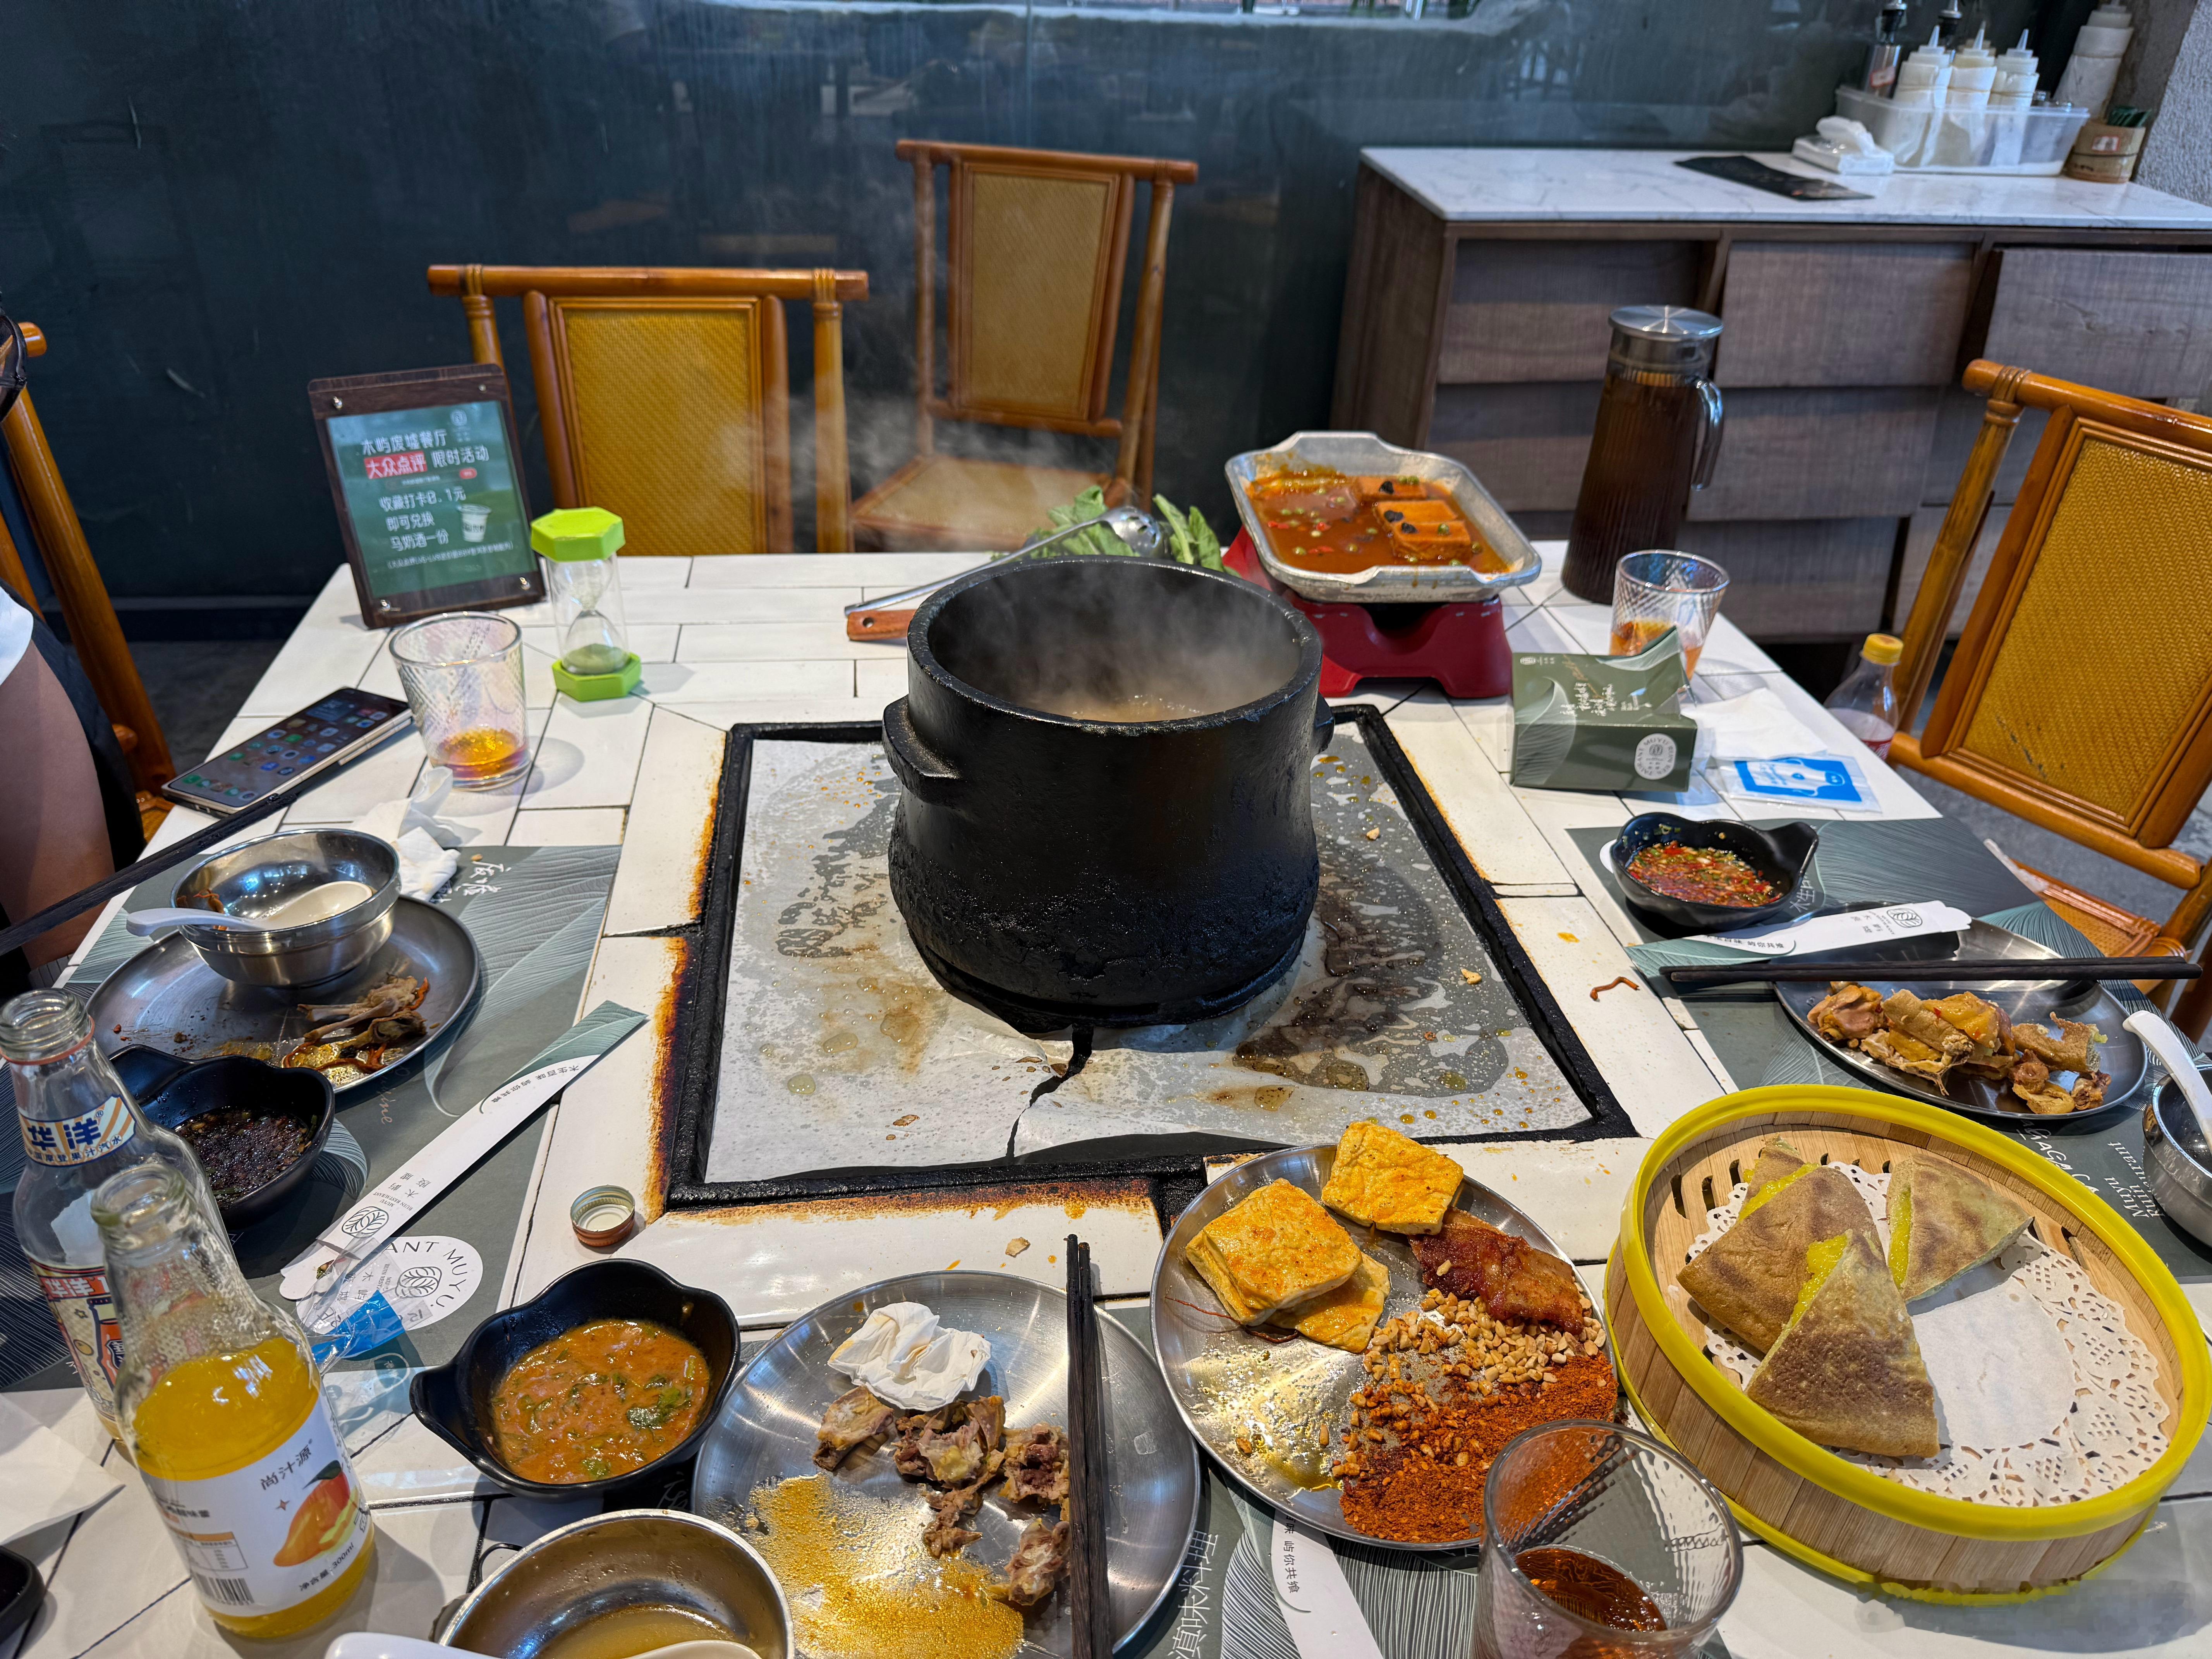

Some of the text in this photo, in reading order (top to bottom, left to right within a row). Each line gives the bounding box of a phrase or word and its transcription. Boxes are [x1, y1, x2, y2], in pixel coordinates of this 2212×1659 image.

[365, 445, 489, 479] 大众点评 限时活动
[386, 511, 435, 531] 即可兑换
[535, 1065, 579, 1080] 木生百味
[28, 1118, 101, 1151] 华洋
[400, 1202, 413, 1211] RUIN
[2104, 1176, 2150, 1218] Muyu
[260, 1443, 312, 1490] 尚汁源
[1283, 1540, 1300, 1594] 屿你共飨
